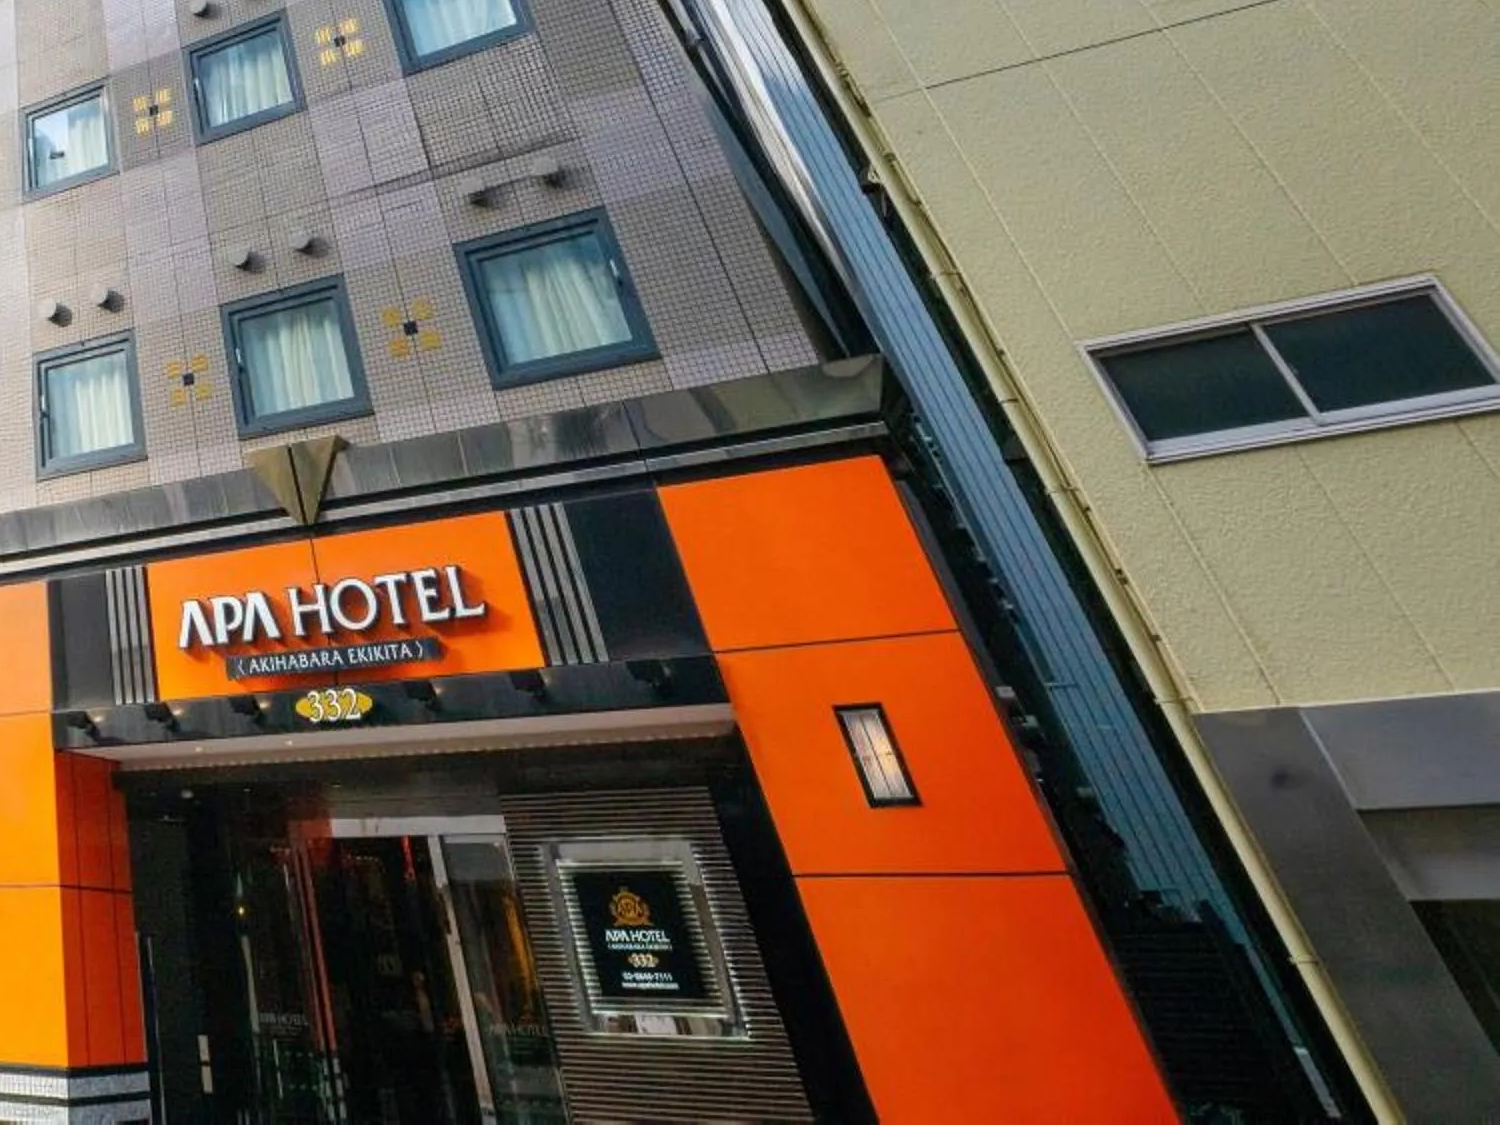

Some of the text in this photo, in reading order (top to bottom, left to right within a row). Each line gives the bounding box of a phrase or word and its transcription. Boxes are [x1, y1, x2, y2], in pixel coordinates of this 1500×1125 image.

[178, 565, 486, 649] APA HOTEL
[306, 688, 362, 724] 332
[630, 930, 671, 942] HOTEL
